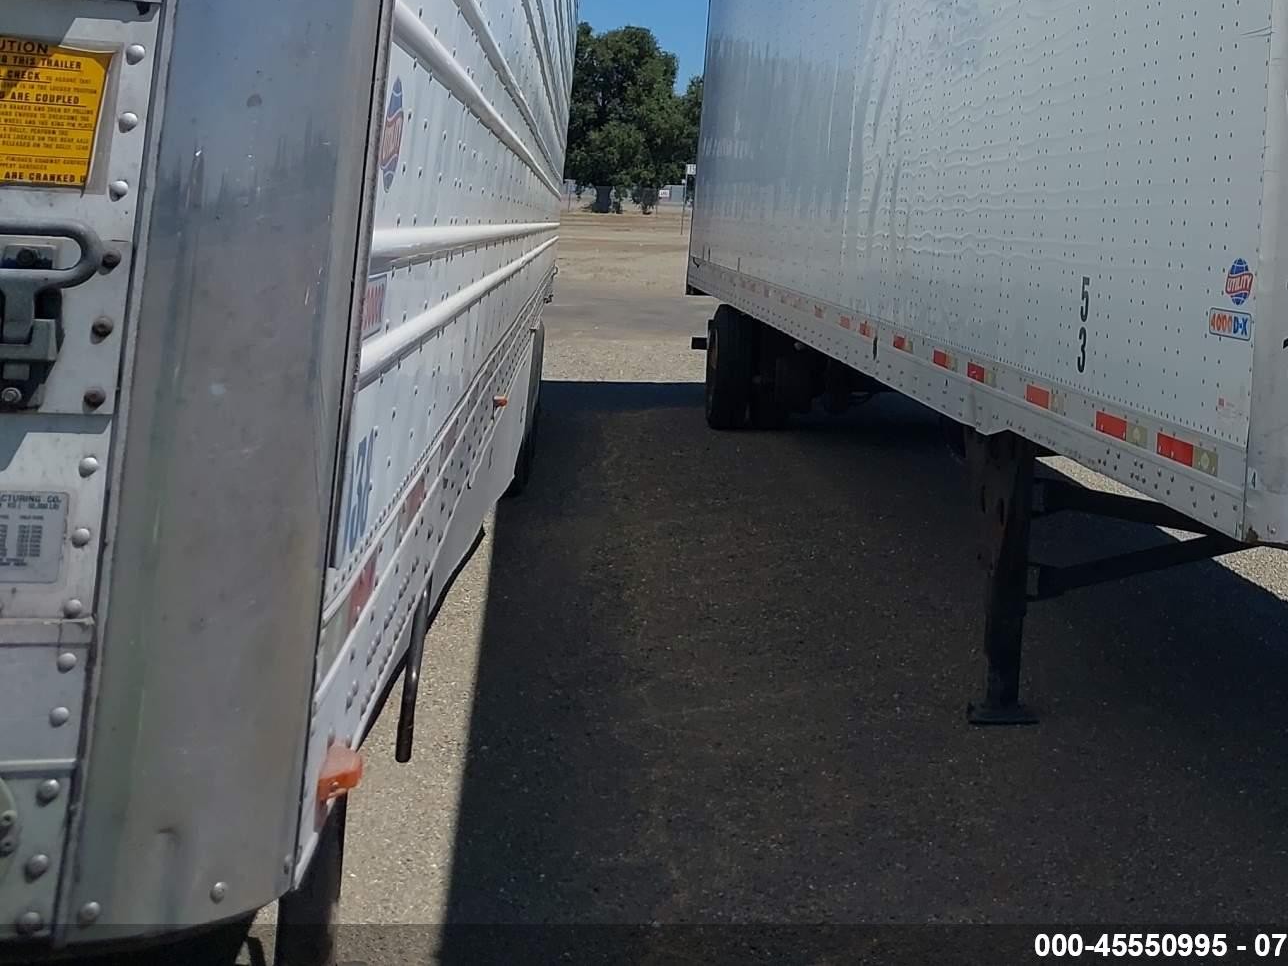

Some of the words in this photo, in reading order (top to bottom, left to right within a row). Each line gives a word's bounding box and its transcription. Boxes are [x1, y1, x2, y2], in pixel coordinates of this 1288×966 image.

[13, 55, 36, 66] THIS
[40, 57, 82, 70] TRAILER
[7, 69, 41, 81] CHECK
[10, 91, 31, 101] ARE
[35, 93, 80, 105] COUPLED
[4, 171, 24, 180] ARE
[29, 172, 76, 183] CRANKED
[1227, 273, 1252, 294] UTILITY
[1076, 275, 1091, 374] 53
